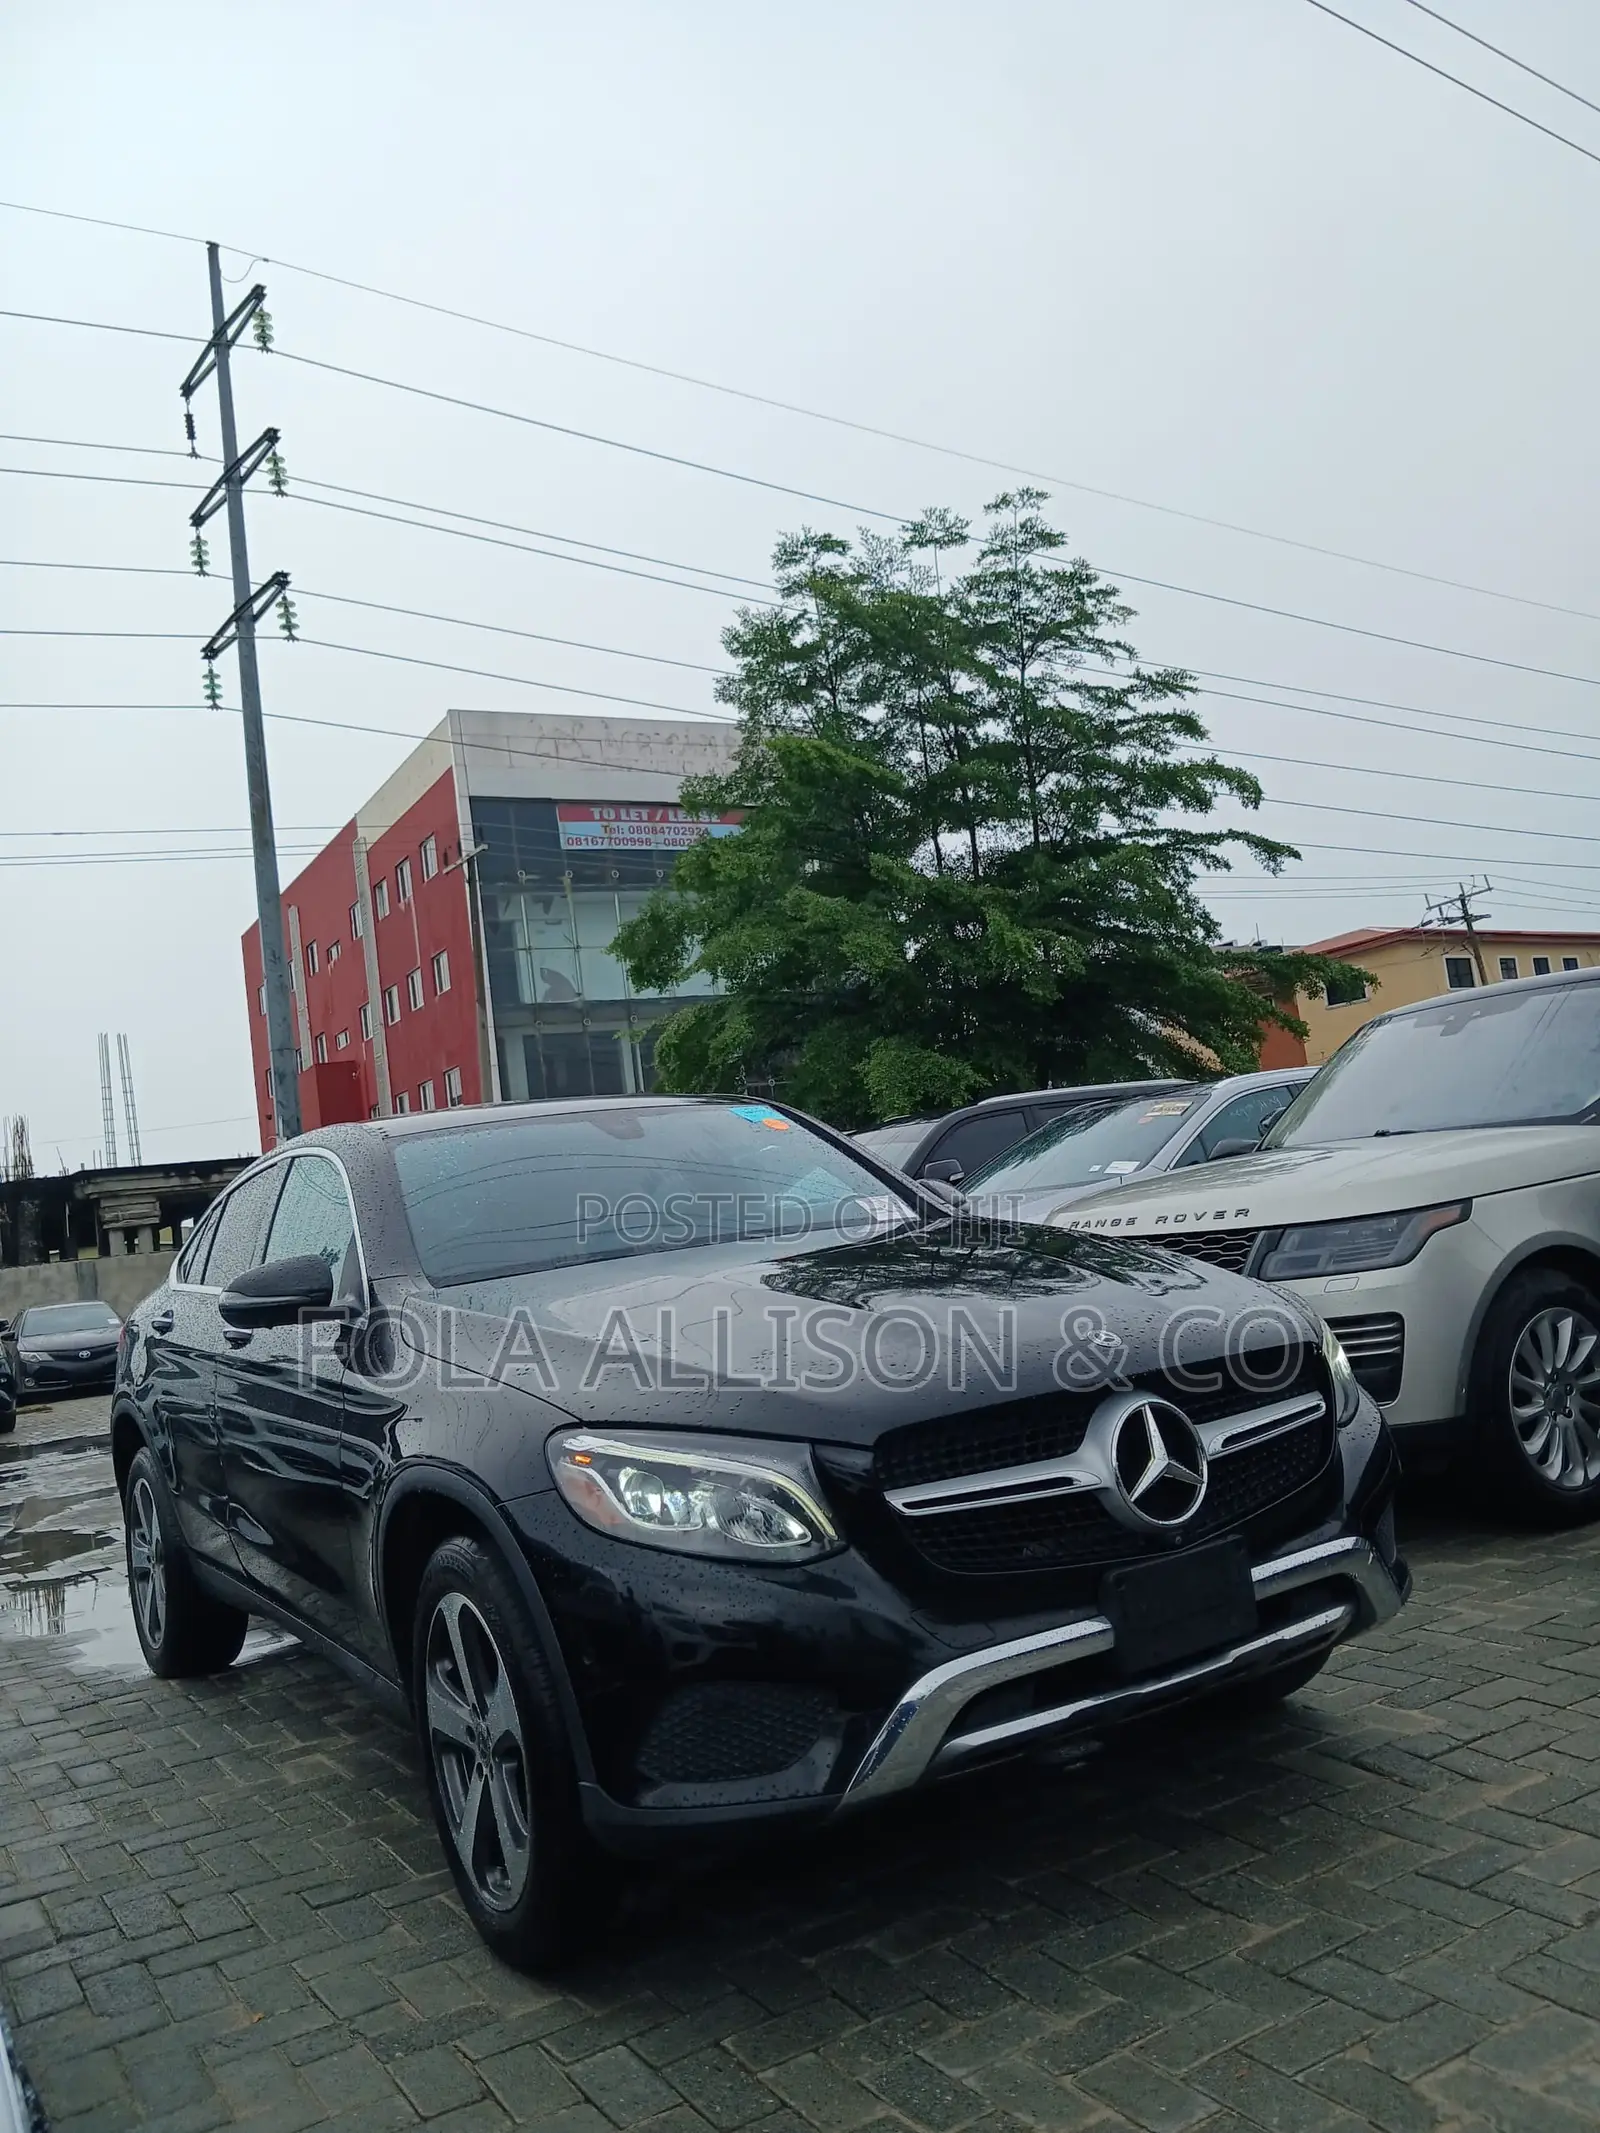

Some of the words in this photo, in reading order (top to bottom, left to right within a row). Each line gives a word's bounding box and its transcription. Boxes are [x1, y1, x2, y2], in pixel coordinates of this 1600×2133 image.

[590, 807, 616, 820] TO
[620, 808, 649, 821] LET
[601, 824, 625, 835] Tel:
[1069, 1217, 1138, 1231] RANGE
[1155, 1208, 1250, 1224] ROVER
